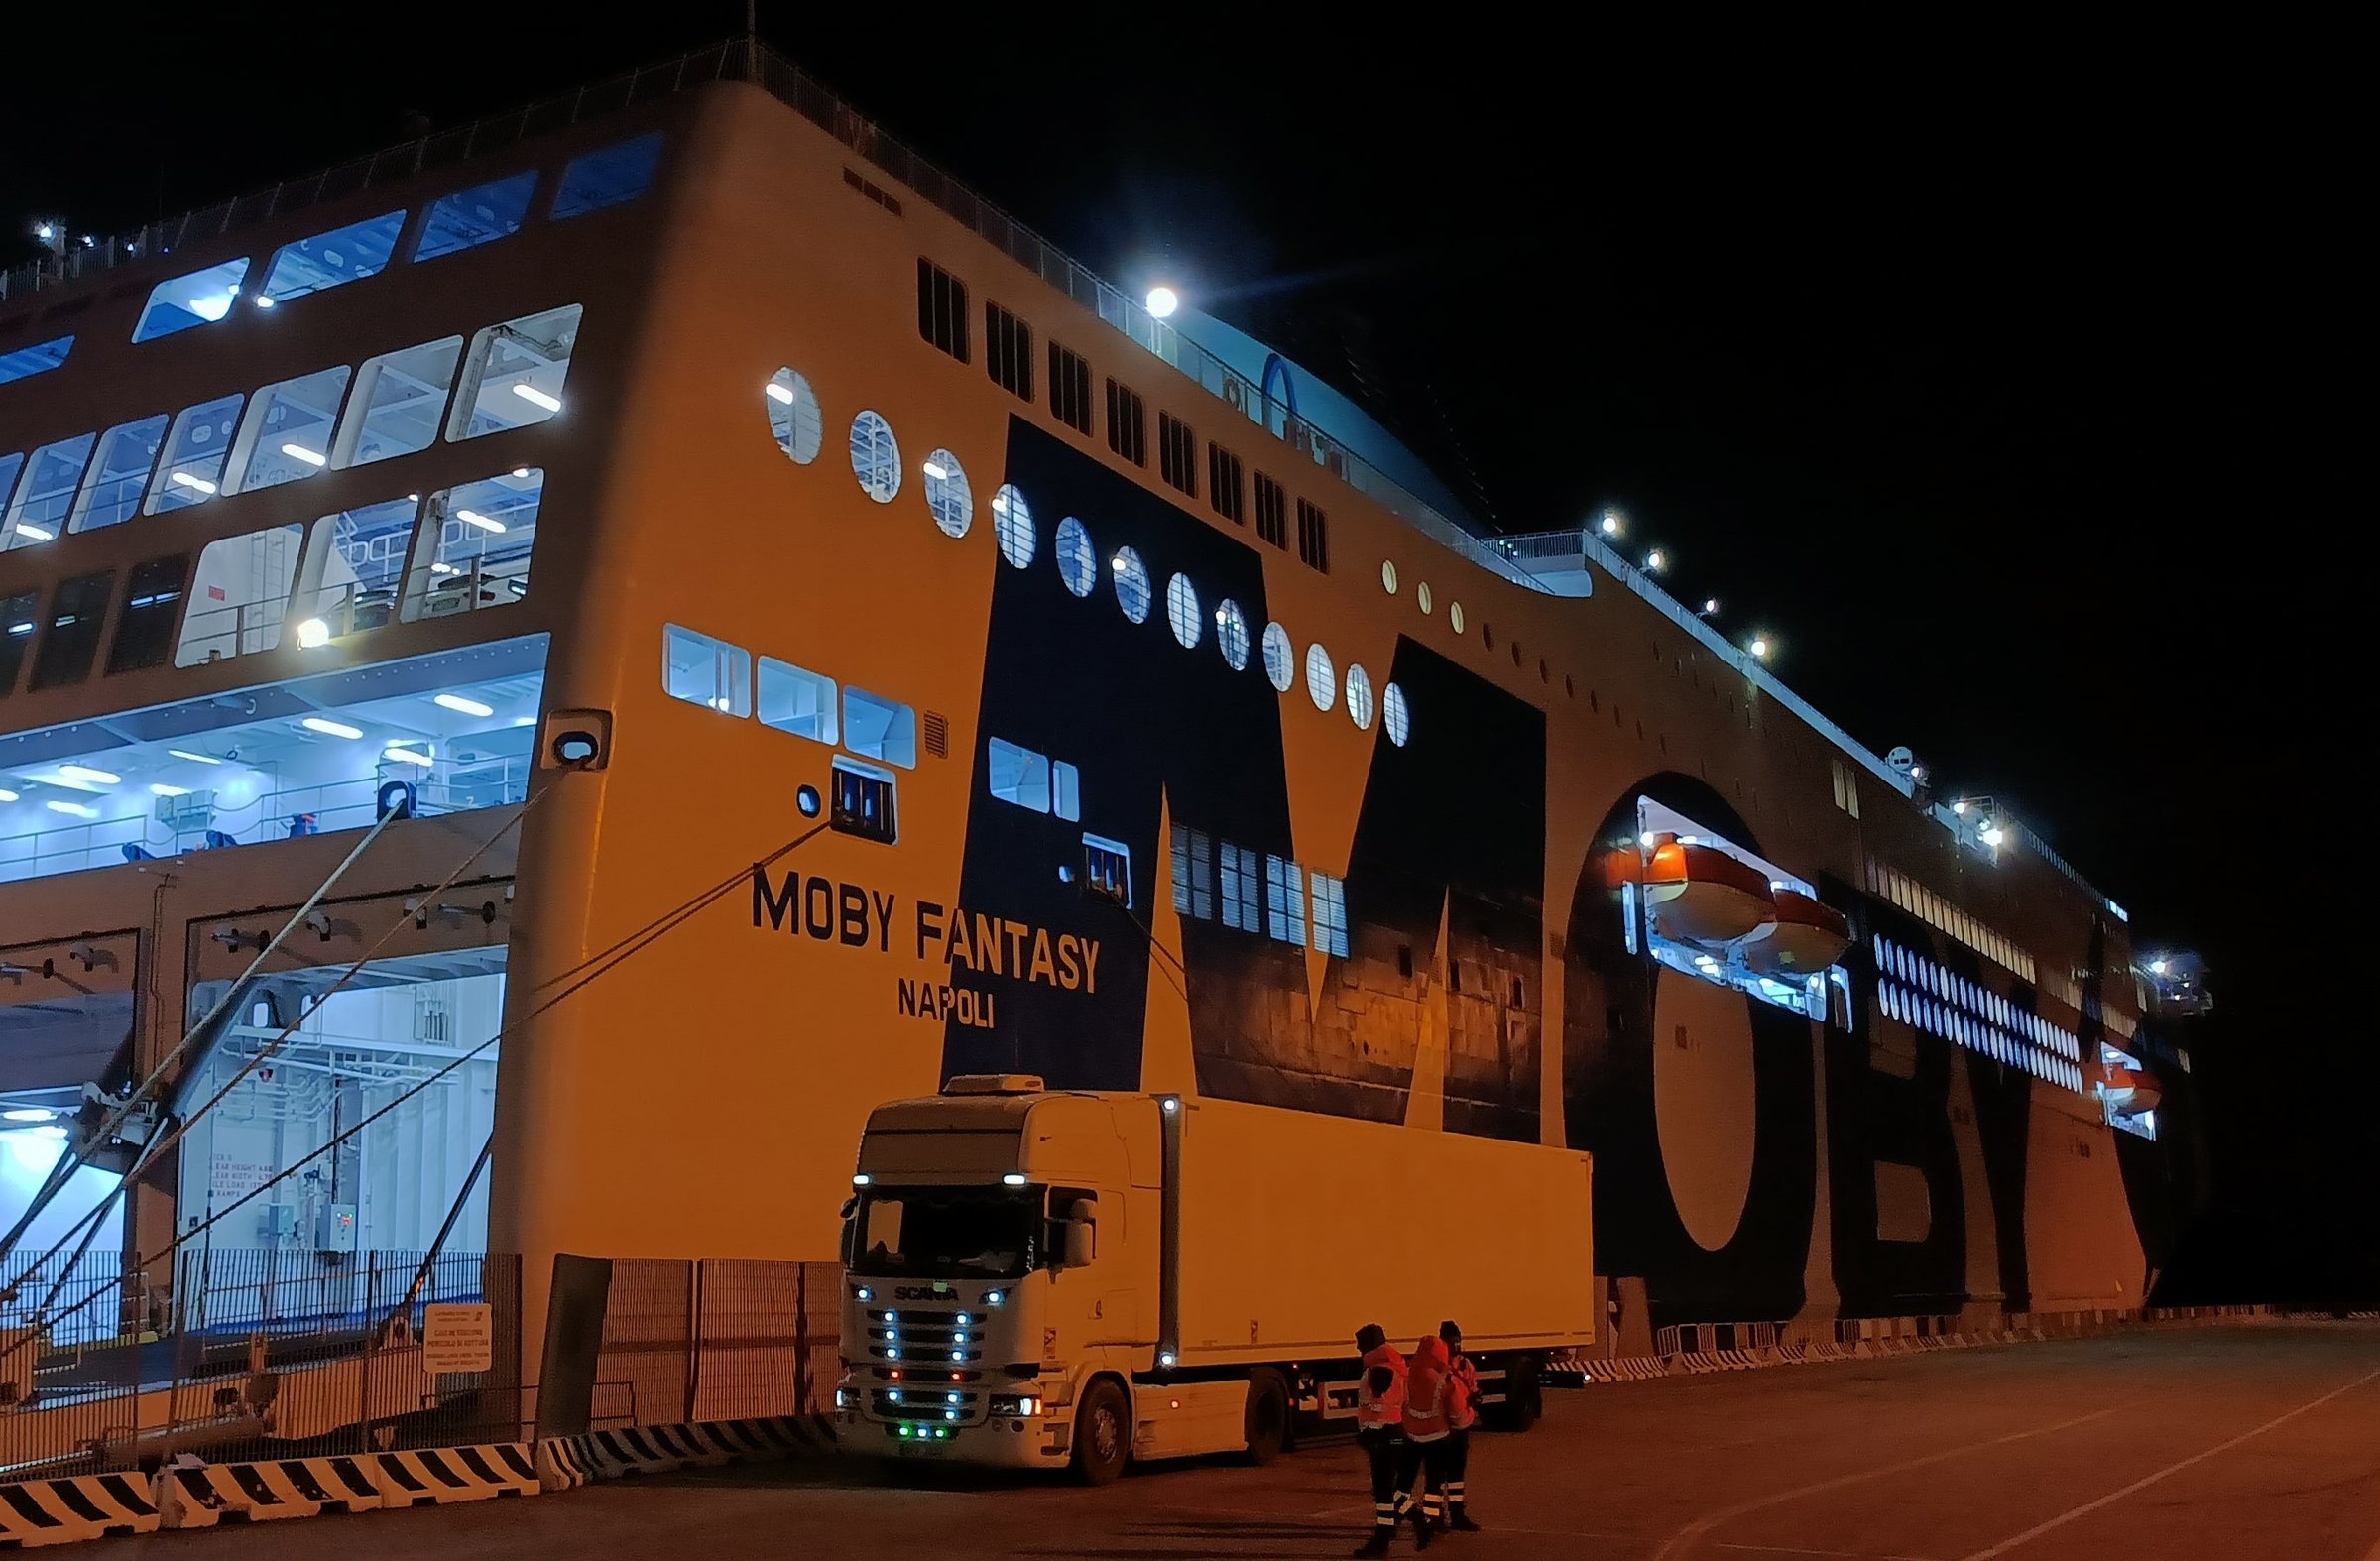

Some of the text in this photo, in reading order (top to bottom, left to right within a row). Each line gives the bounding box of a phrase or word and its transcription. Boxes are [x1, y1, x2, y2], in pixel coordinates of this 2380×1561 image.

[752, 862, 1100, 994] MOBY FANTASY
[897, 977, 994, 1029] NAPOLI
